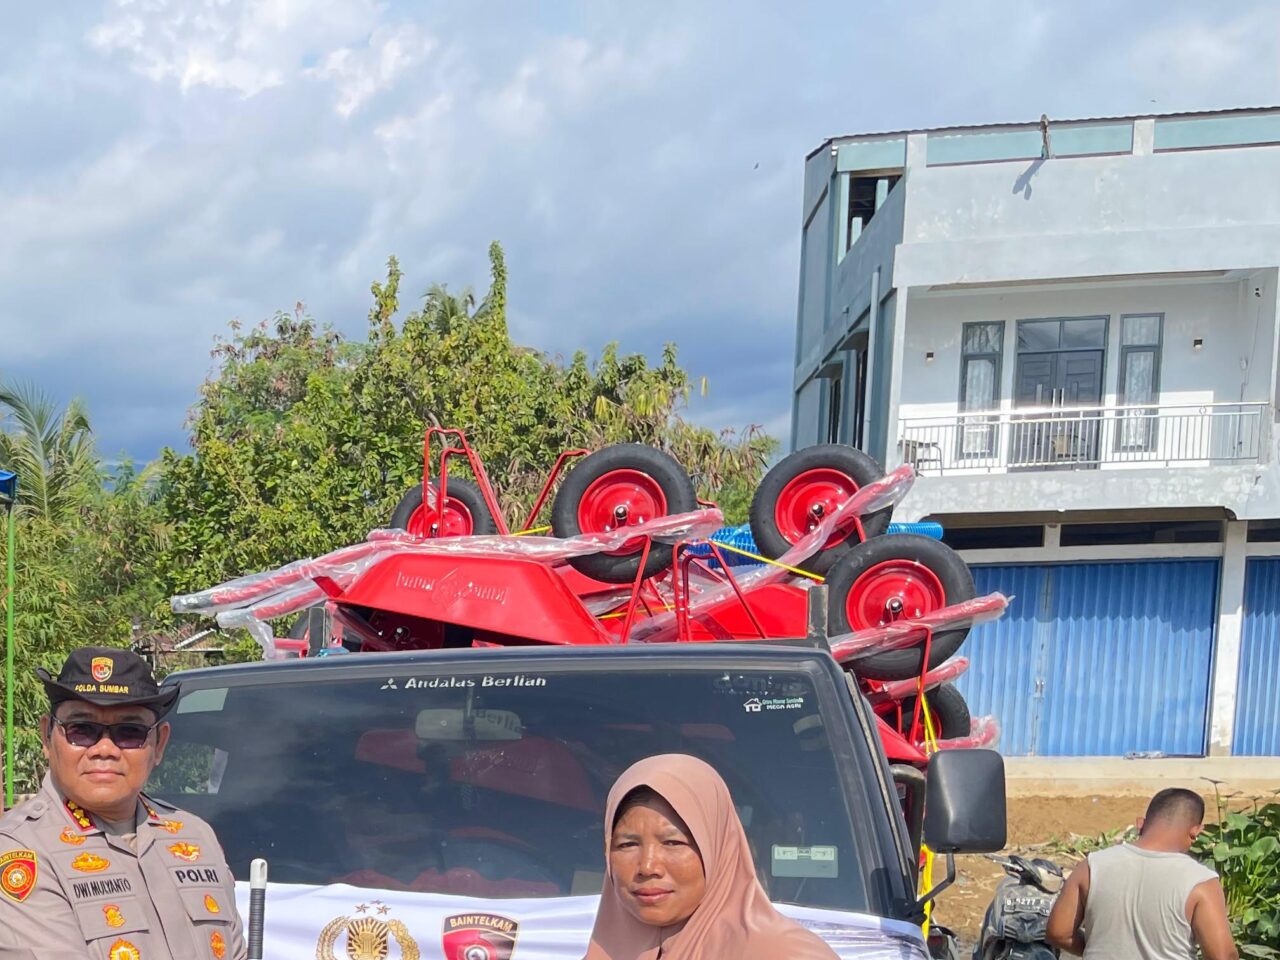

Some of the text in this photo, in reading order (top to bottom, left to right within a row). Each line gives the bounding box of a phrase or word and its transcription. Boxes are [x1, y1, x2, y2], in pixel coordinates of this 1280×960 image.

[100, 685, 129, 694] SUMBAR
[405, 675, 547, 689] Andalas Berlian
[175, 869, 220, 884] POLRI
[73, 878, 132, 899] DWI MULYANTO
[450, 916, 514, 933] BAINTELKAM
